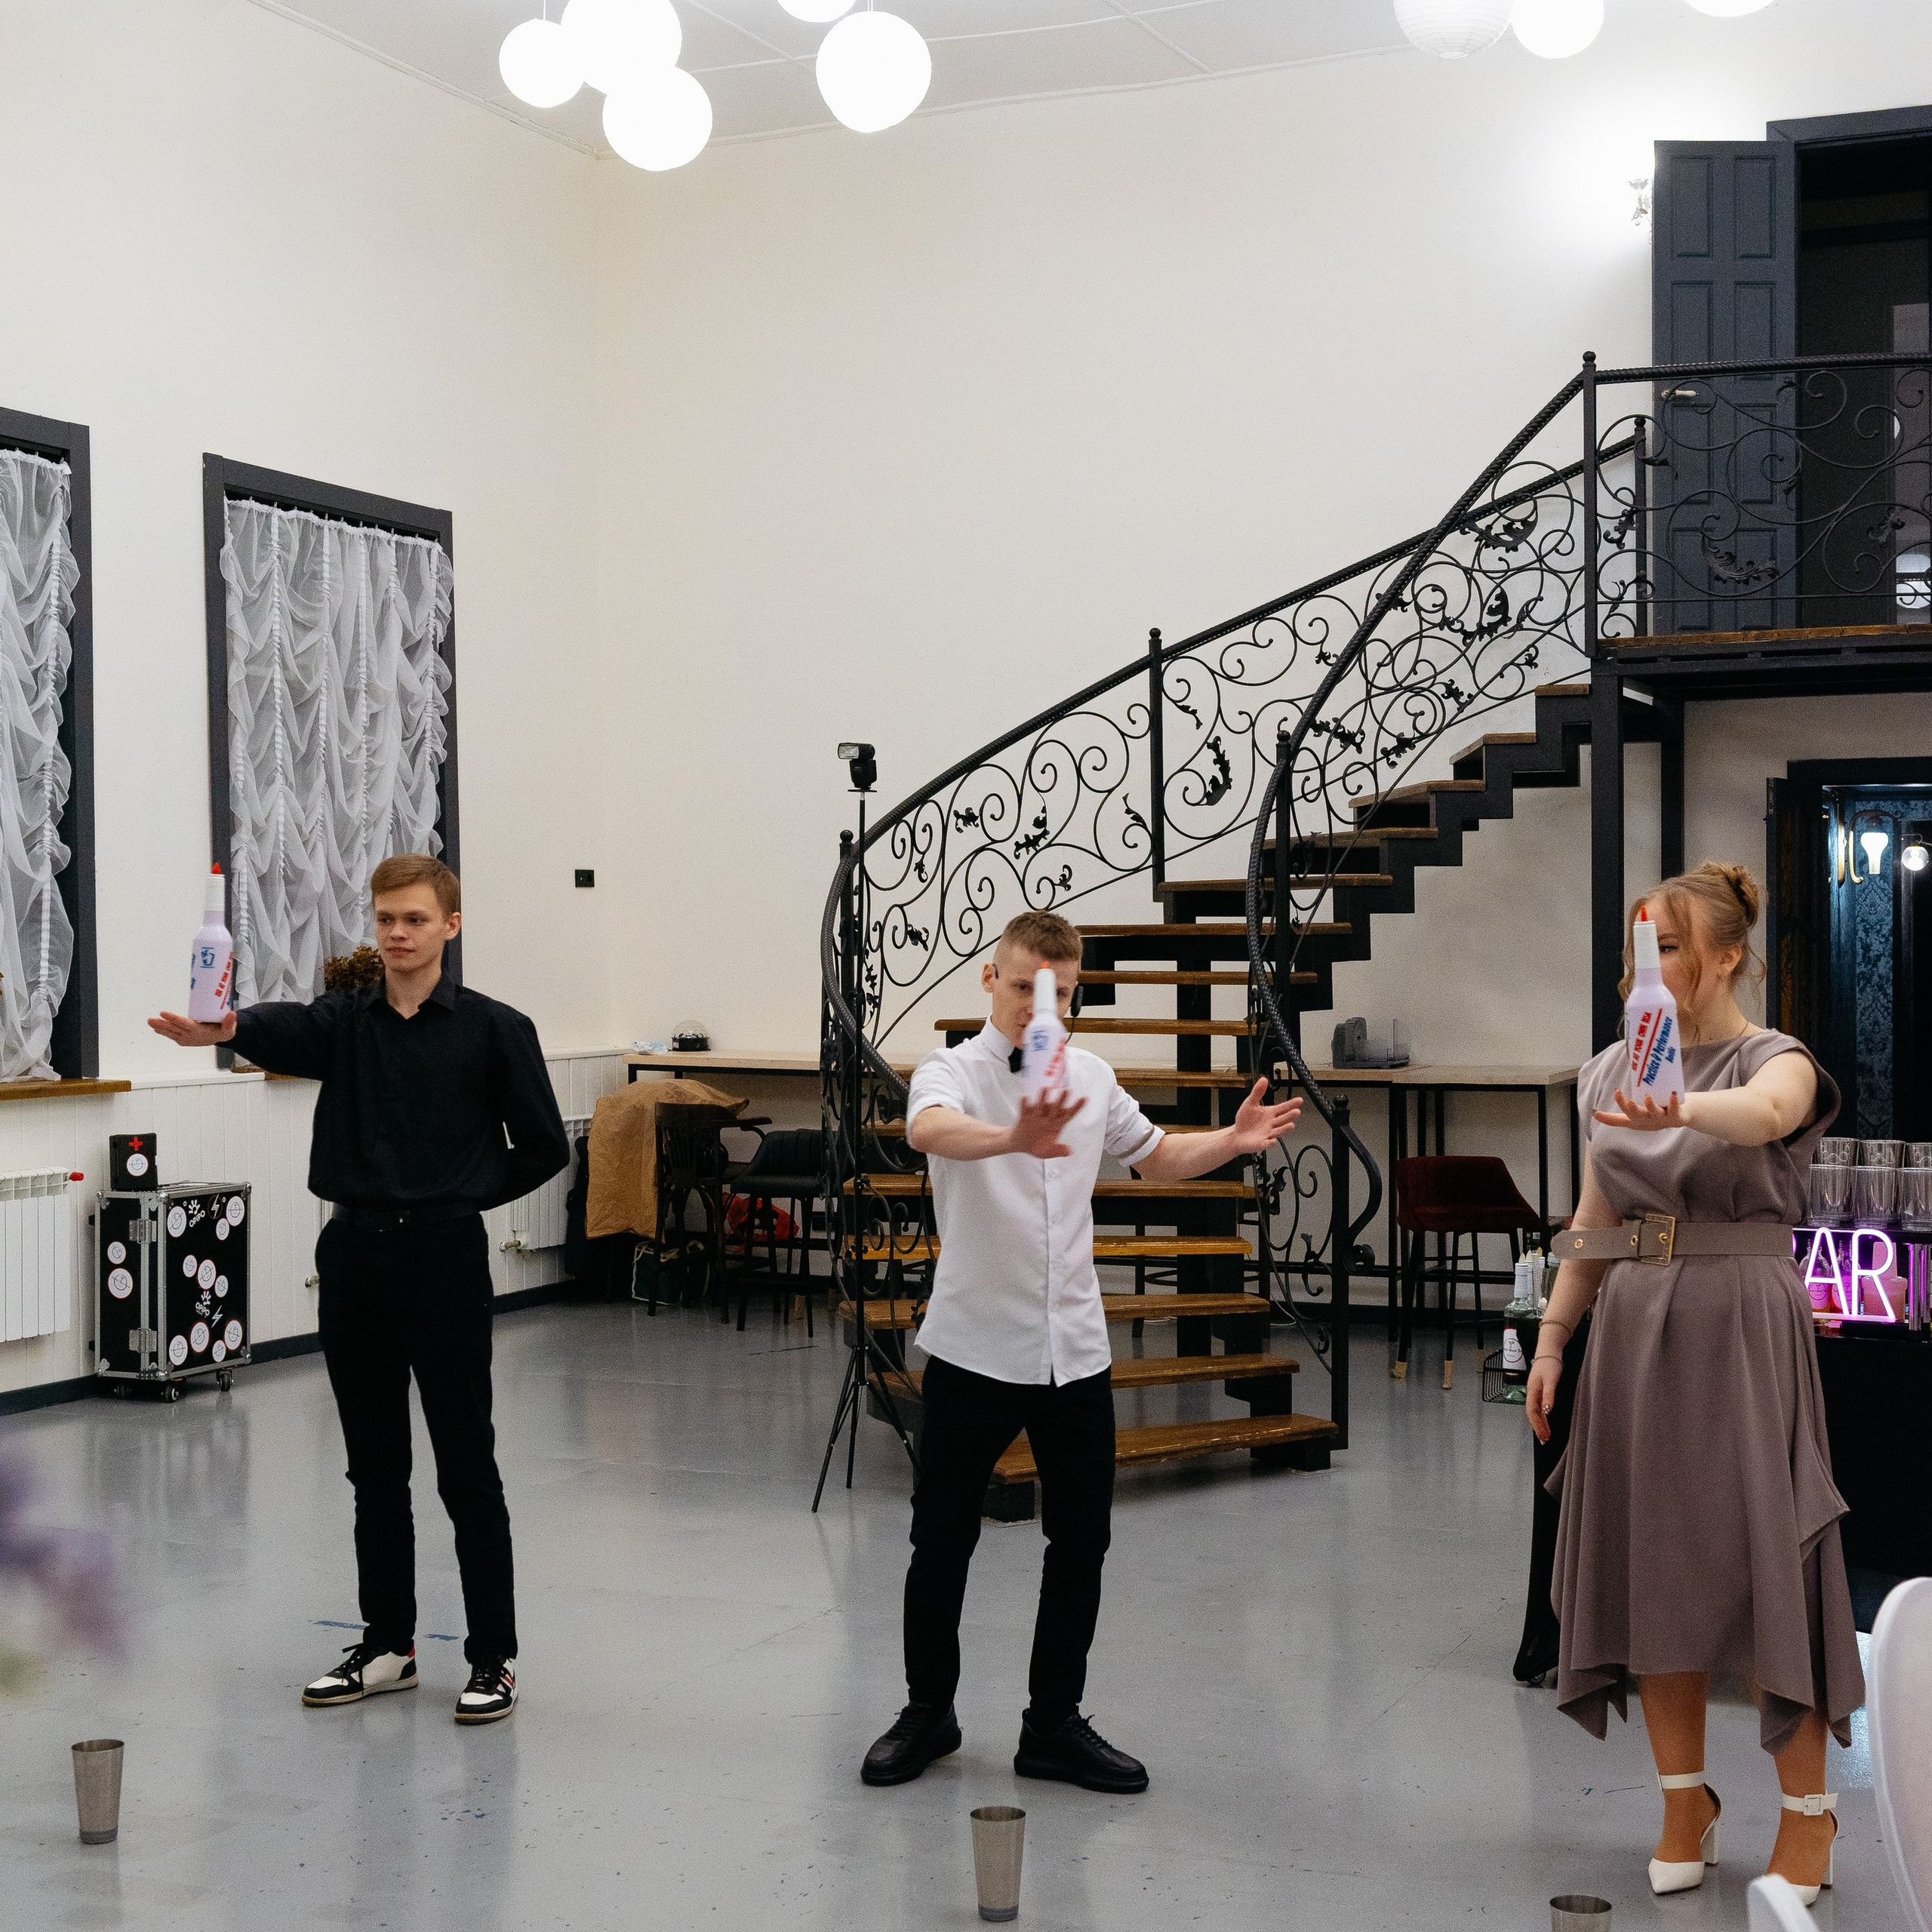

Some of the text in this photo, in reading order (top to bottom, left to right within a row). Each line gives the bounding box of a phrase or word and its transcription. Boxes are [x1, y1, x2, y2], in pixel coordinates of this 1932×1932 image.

[1642, 1060, 1660, 1086] Practice
[1653, 1016, 1673, 1057] Performance
[1793, 1227, 1897, 1322] AR
